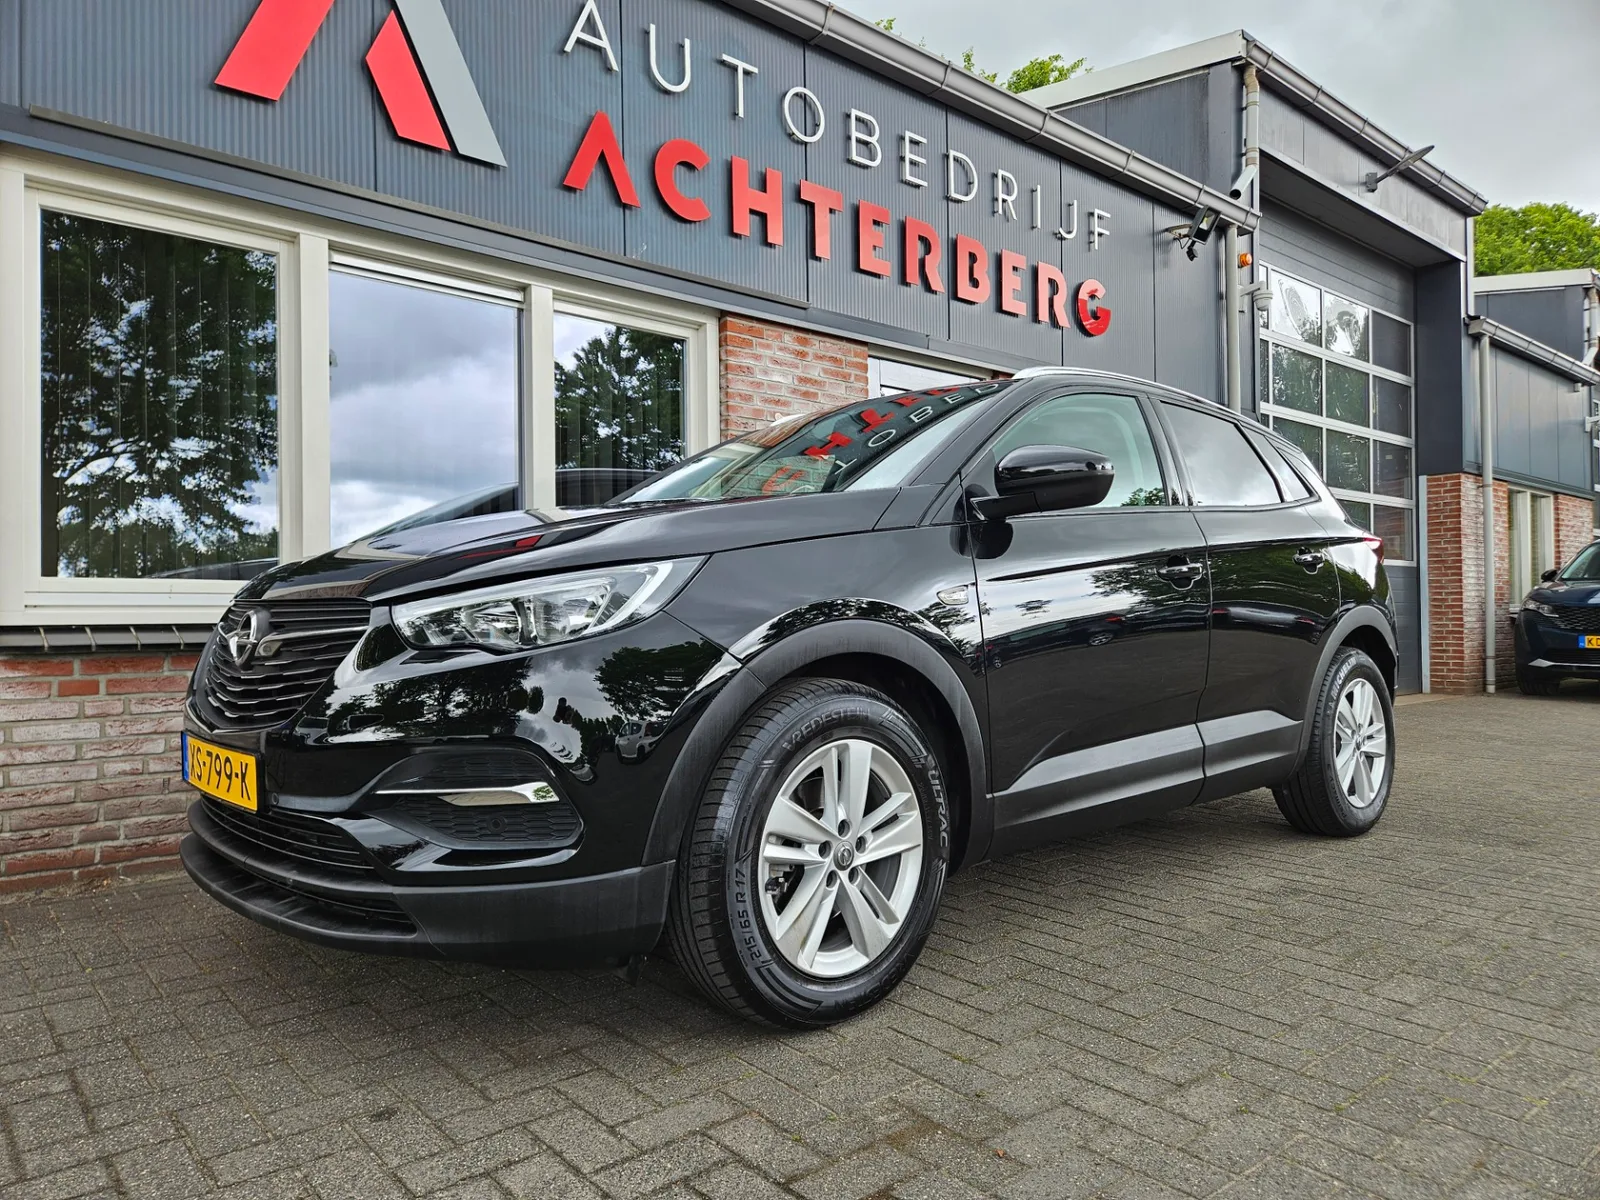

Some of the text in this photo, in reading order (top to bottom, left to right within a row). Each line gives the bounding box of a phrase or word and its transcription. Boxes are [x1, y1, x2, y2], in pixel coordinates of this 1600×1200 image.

[563, 0, 1111, 251] AUTOBEDRIJF
[563, 110, 1112, 337] ACHTERBERG
[782, 707, 871, 751] VREDESTEIN
[189, 743, 251, 801] XS-799-K
[927, 769, 948, 848] ULTRAC
[737, 909, 762, 961] 215/65
